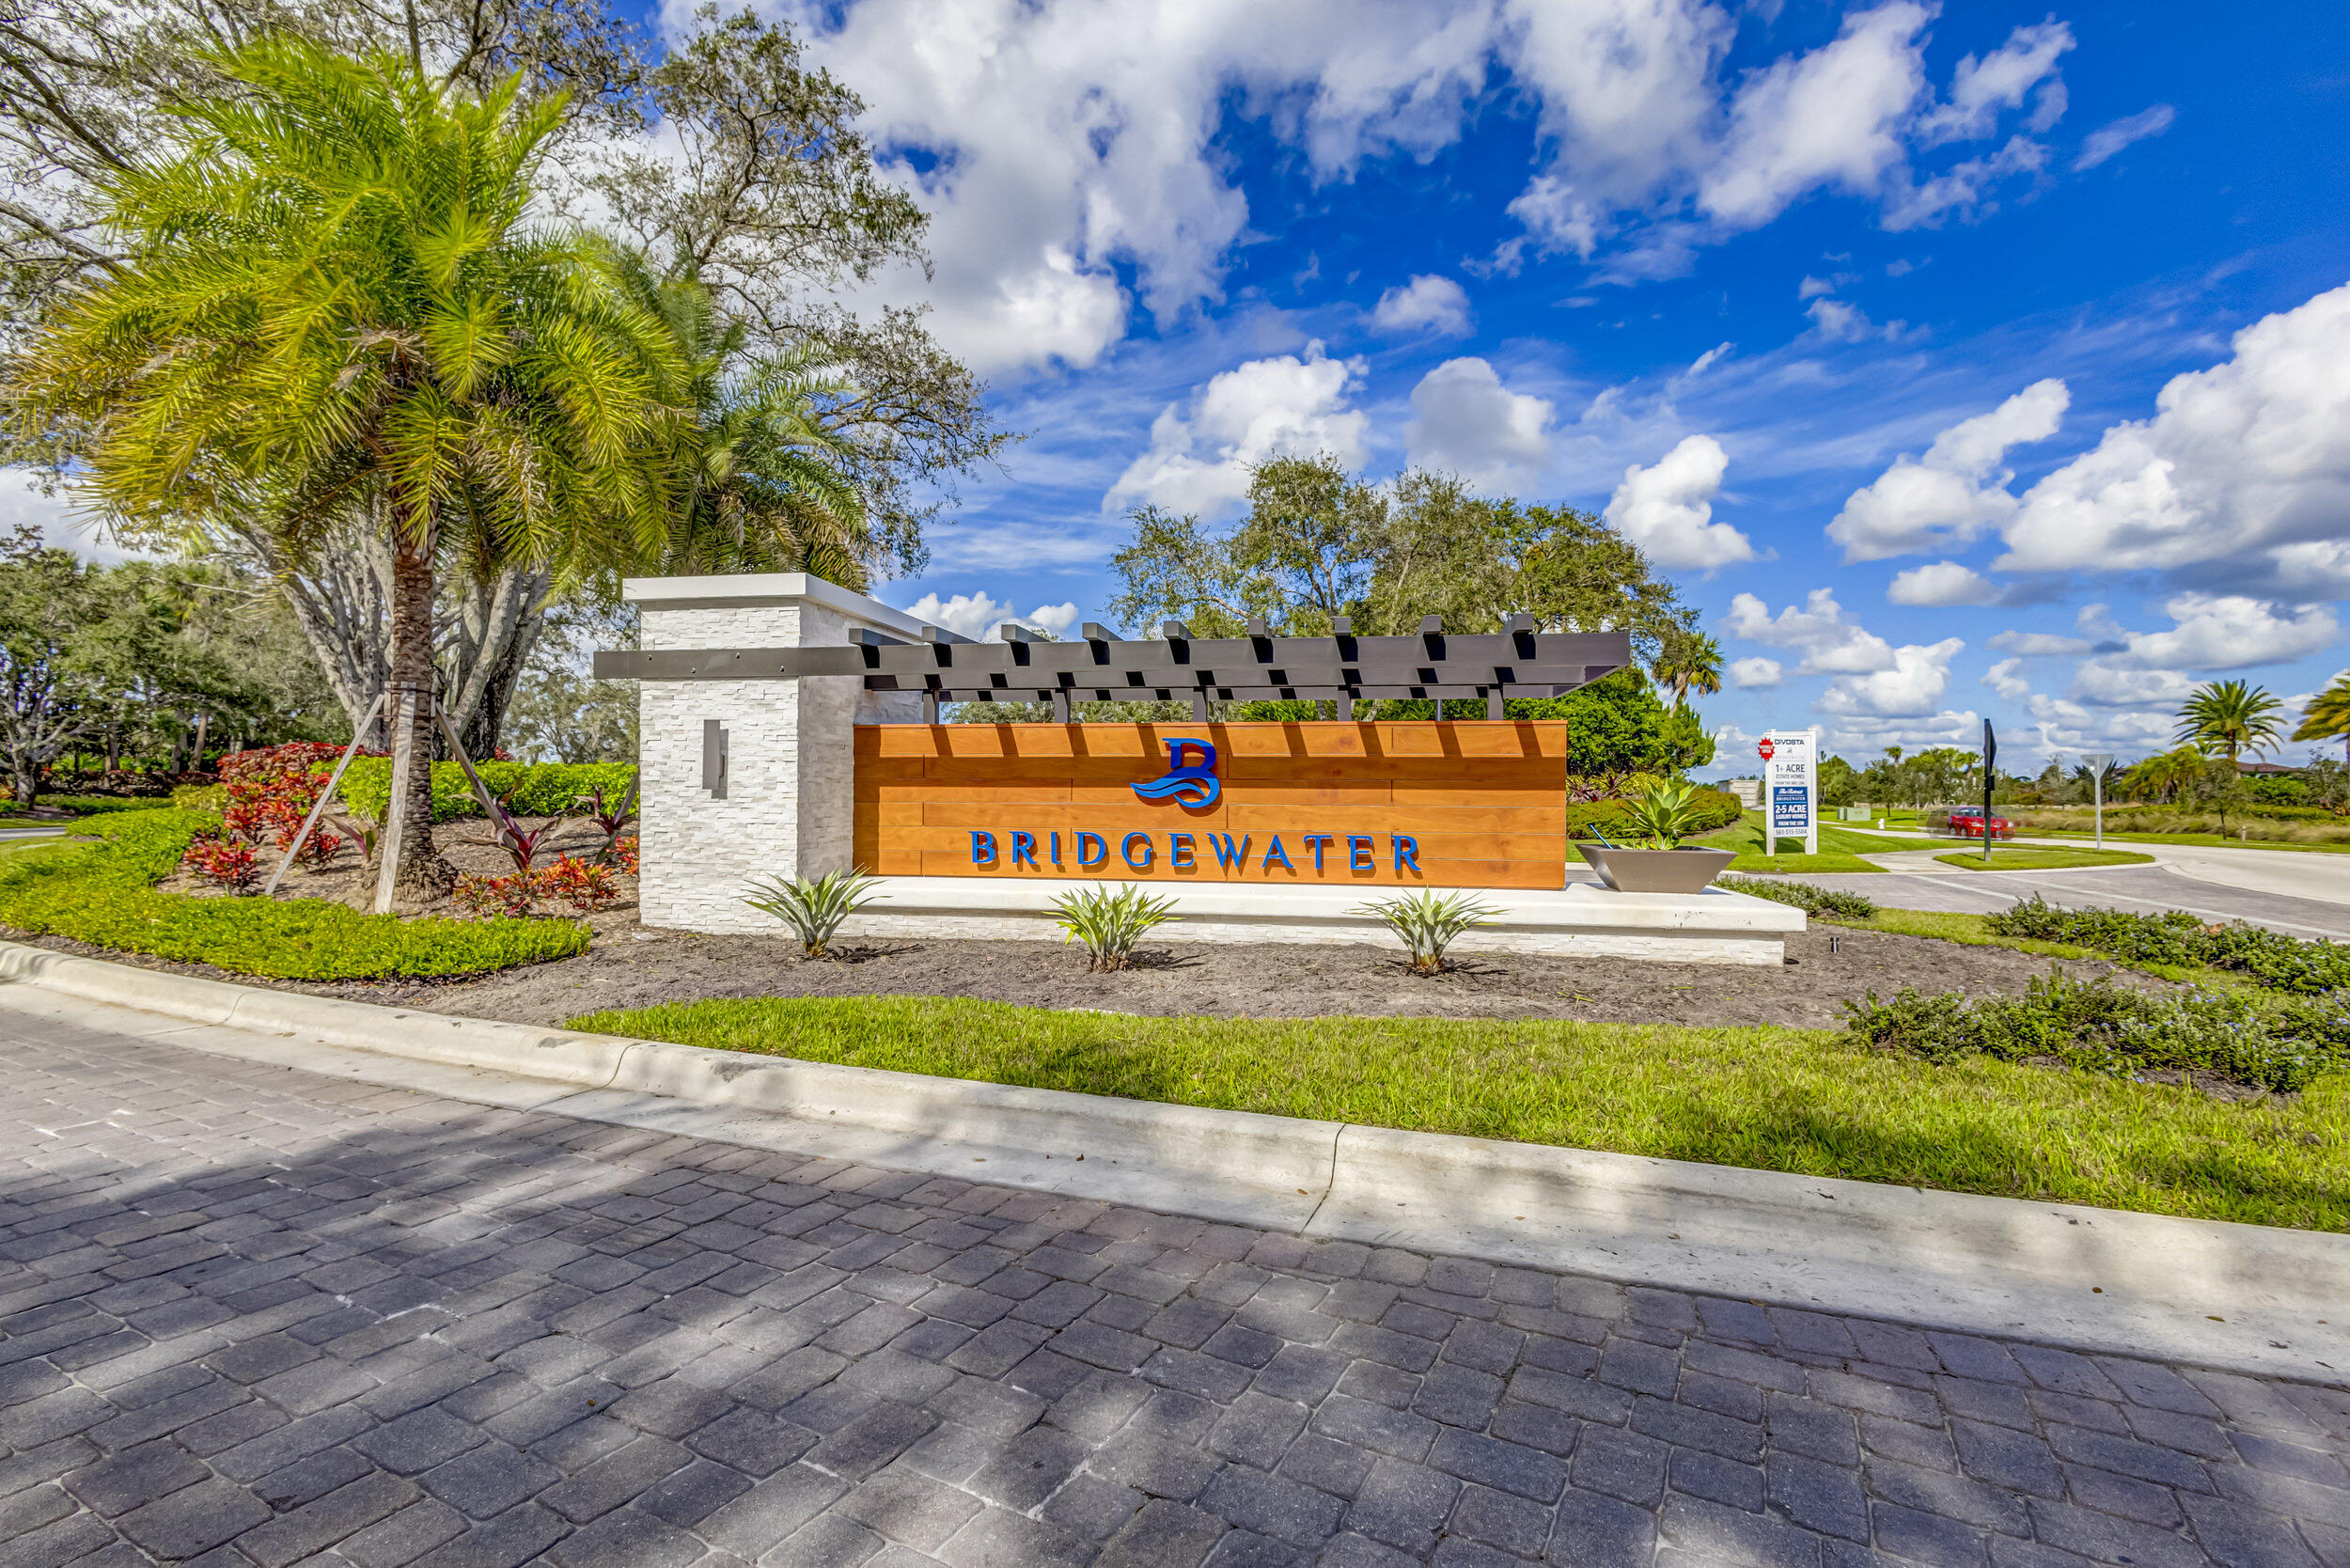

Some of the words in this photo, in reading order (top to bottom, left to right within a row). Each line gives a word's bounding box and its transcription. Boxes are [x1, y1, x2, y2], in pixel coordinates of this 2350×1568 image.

[1786, 763, 1806, 773] ACRE
[1775, 804, 1787, 814] 2-5
[1788, 804, 1807, 813] ACRE
[968, 830, 1421, 871] BRIDGEWATER
